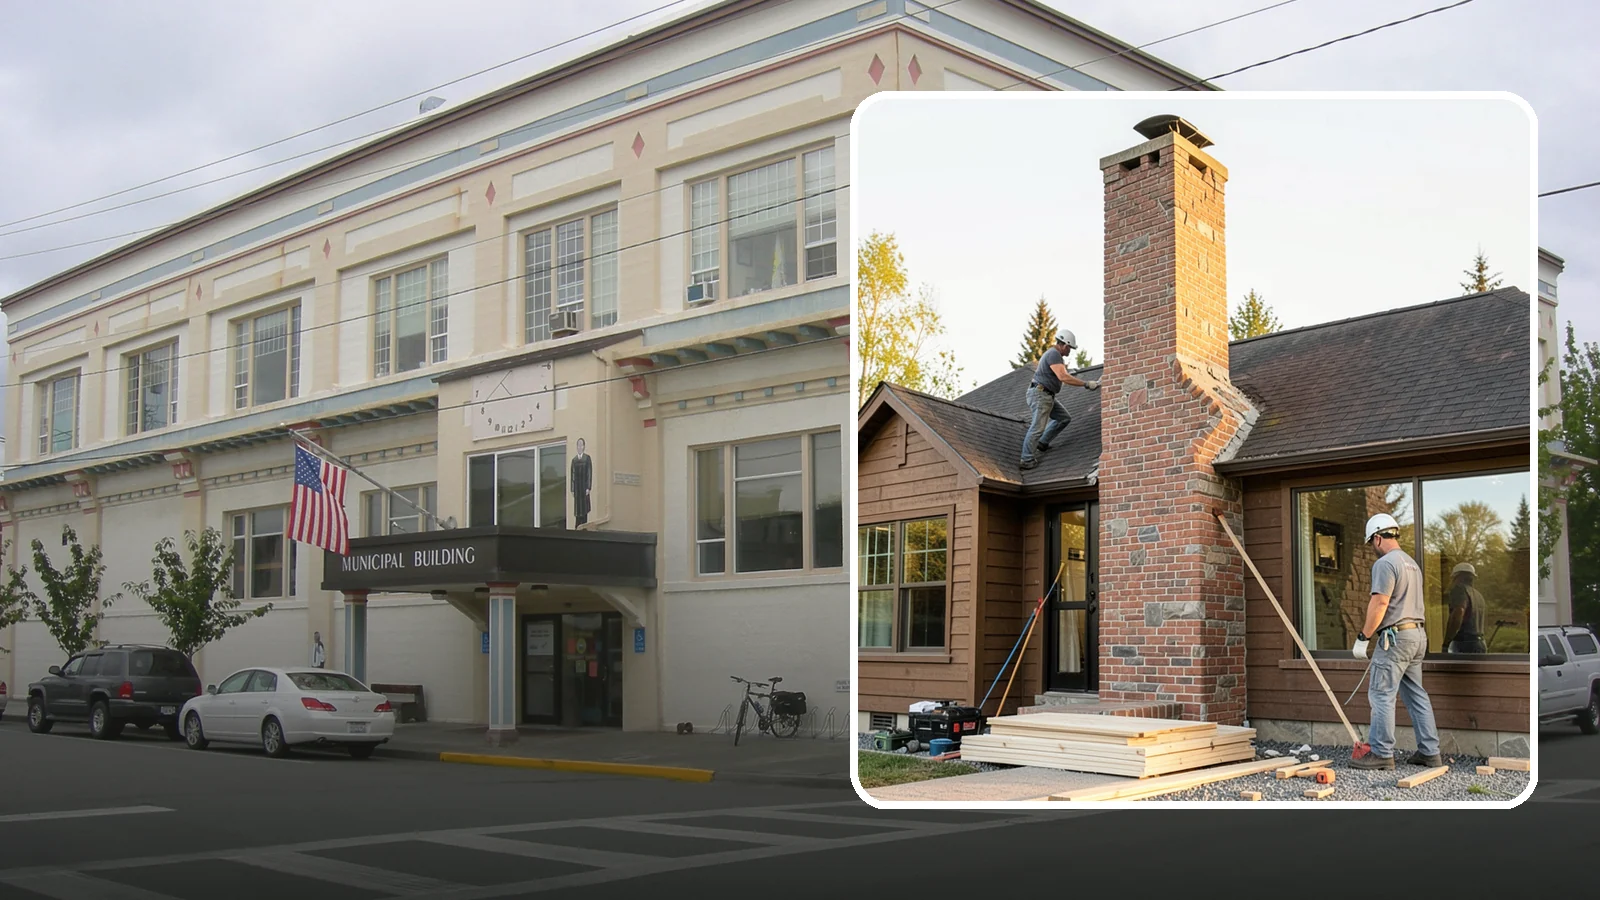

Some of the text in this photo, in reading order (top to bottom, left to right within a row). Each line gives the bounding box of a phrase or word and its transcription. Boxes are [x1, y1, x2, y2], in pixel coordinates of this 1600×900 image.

[480, 407, 484, 415] 8
[488, 418, 492, 426] 9
[494, 424, 500, 432] 10
[502, 426, 506, 434] 11
[521, 420, 526, 428] 2
[529, 414, 533, 422] 3
[342, 546, 475, 572] MUNICIPAL BUILDING
